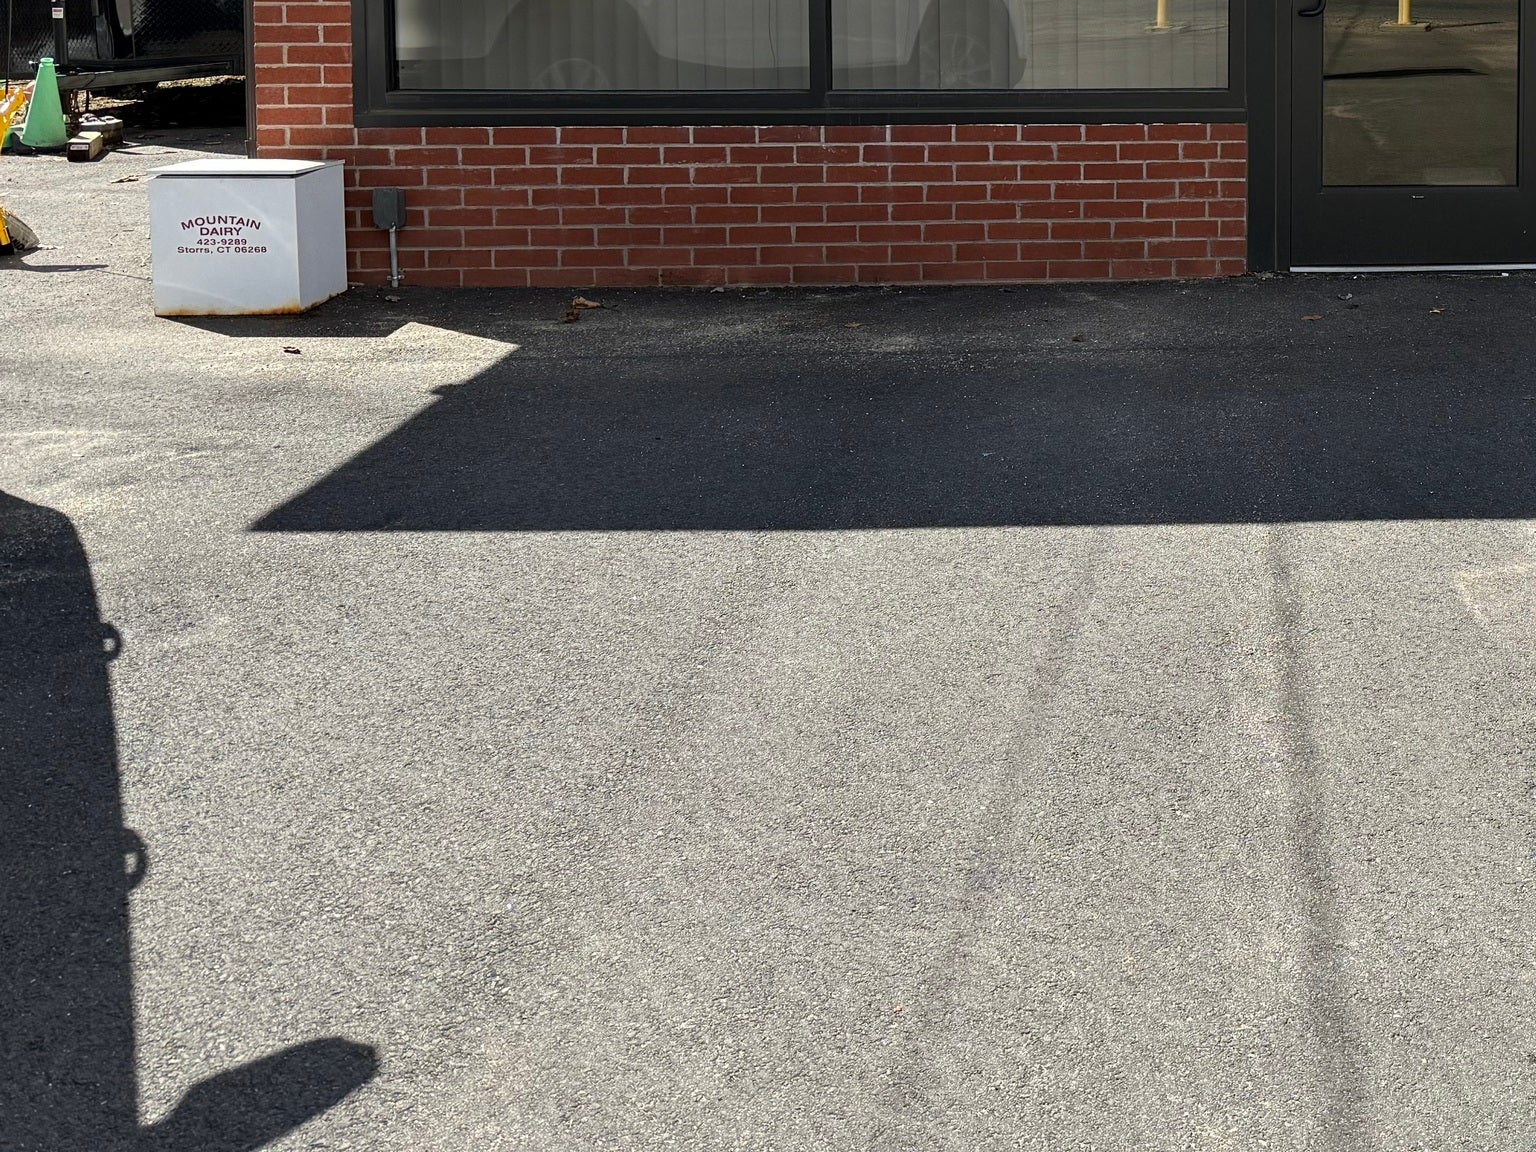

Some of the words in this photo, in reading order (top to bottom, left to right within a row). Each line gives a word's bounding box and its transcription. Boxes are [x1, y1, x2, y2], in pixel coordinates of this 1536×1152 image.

[181, 215, 261, 230] MOUNTAIN
[199, 227, 242, 236] DAIRY
[177, 246, 213, 254] Storrs,
